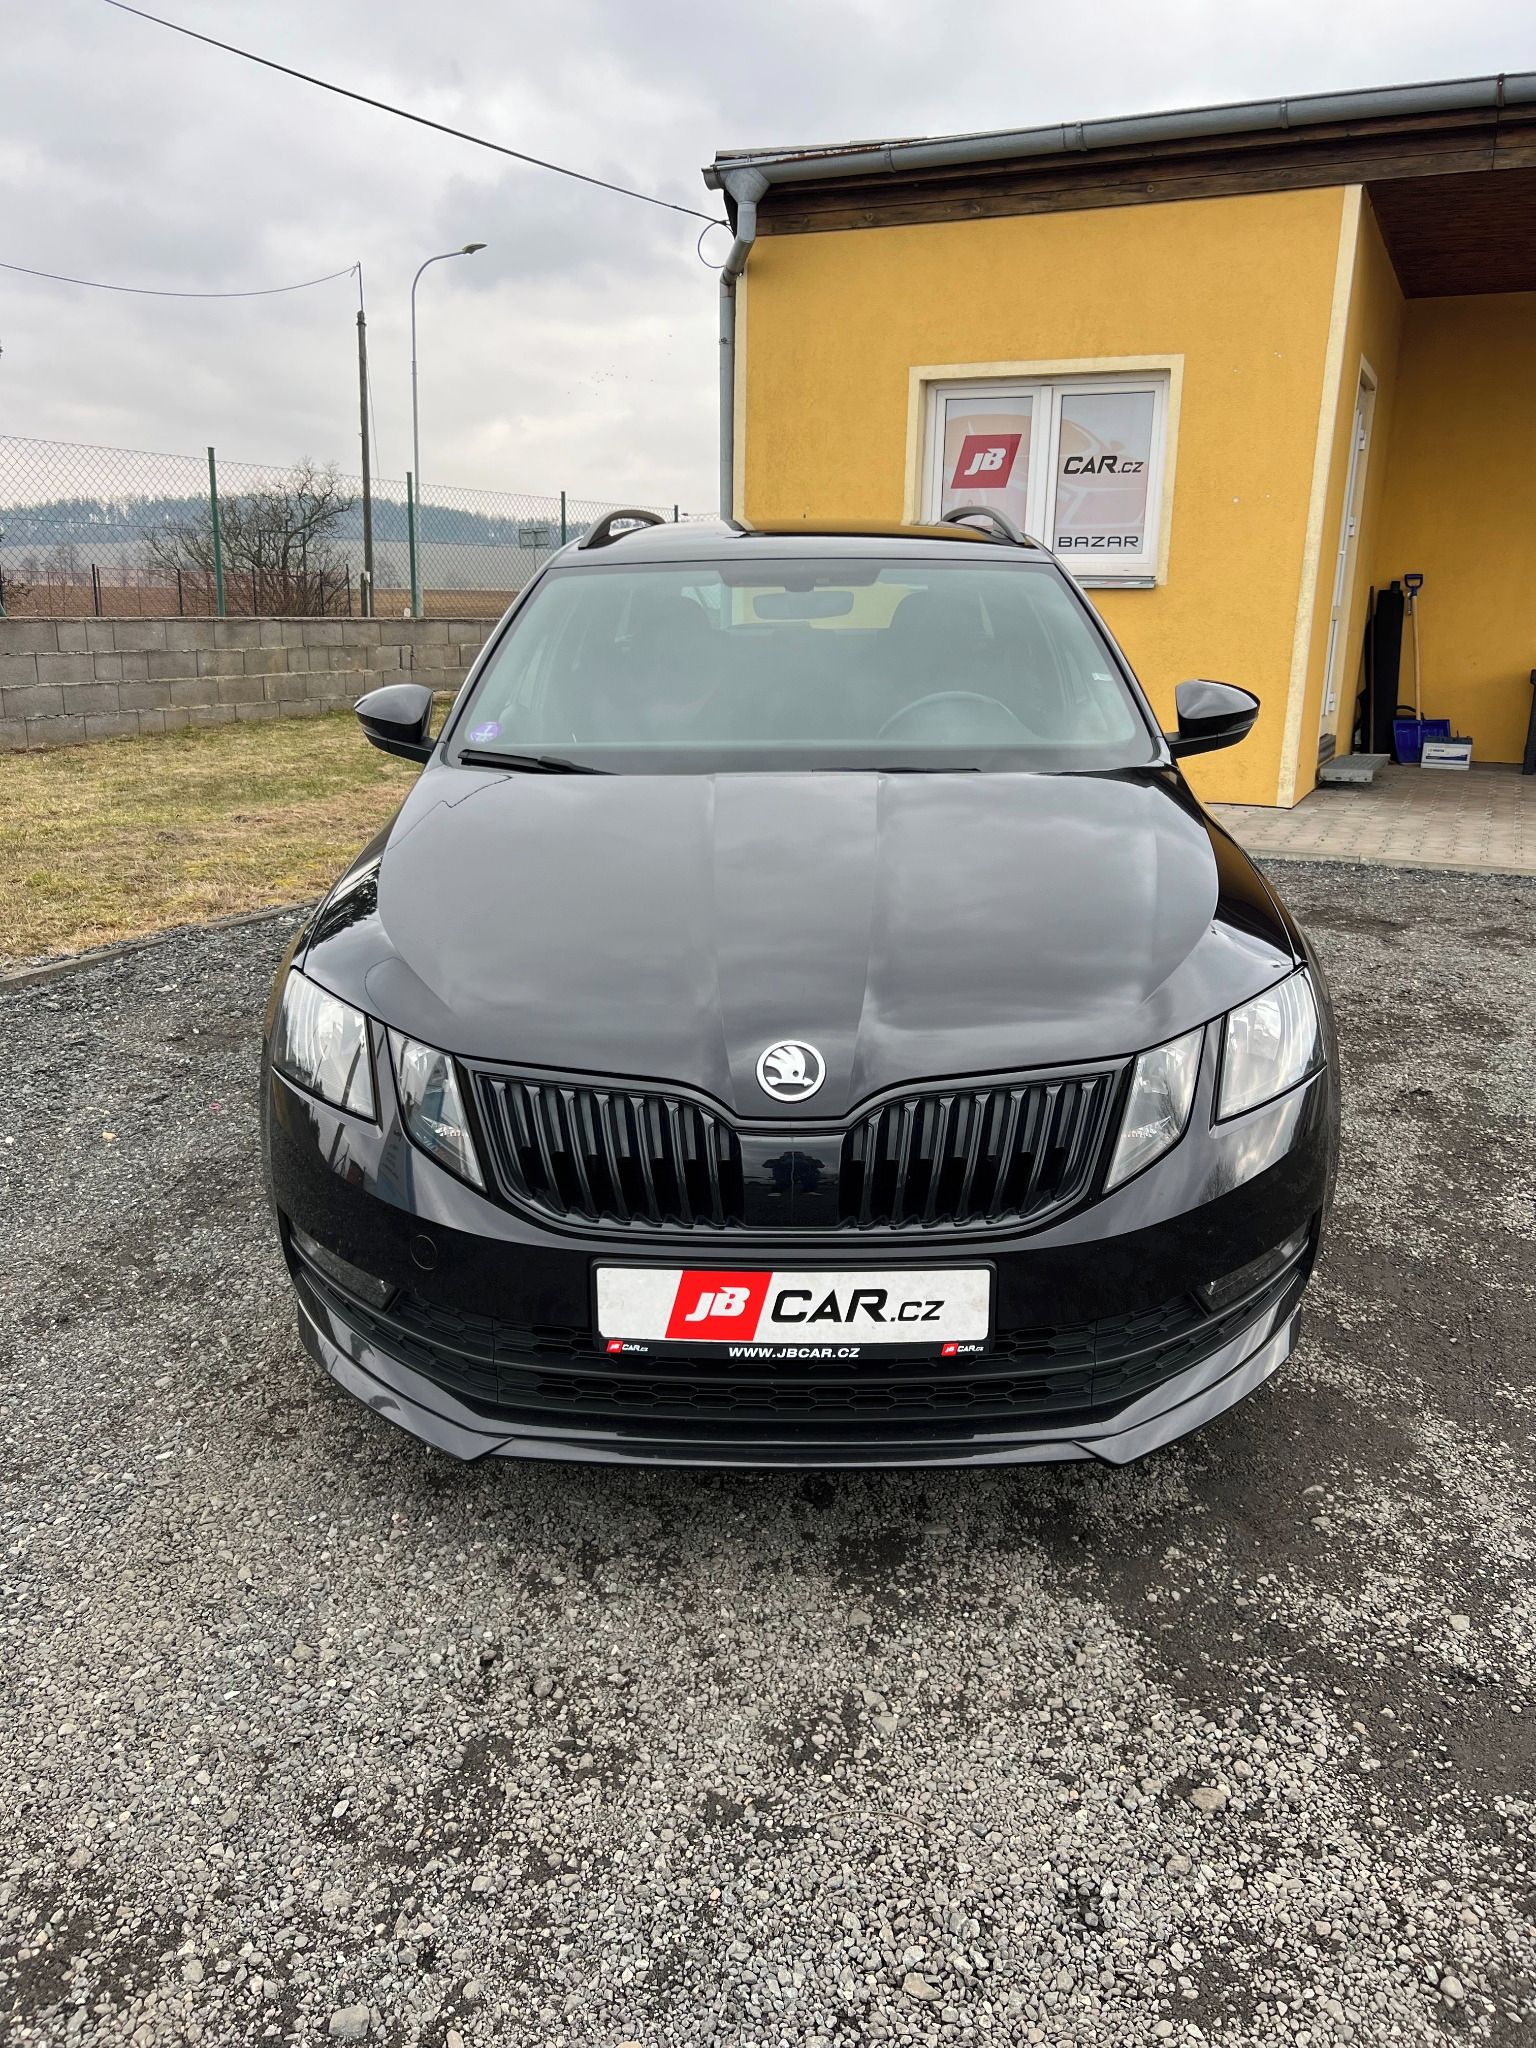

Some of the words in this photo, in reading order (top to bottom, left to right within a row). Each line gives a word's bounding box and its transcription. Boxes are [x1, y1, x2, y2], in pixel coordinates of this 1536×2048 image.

[964, 448, 1007, 476] JB
[1058, 535, 1139, 548] BAZAR
[685, 1286, 751, 1322] JB
[728, 1347, 861, 1359] WWW.JBCAR.CZ
